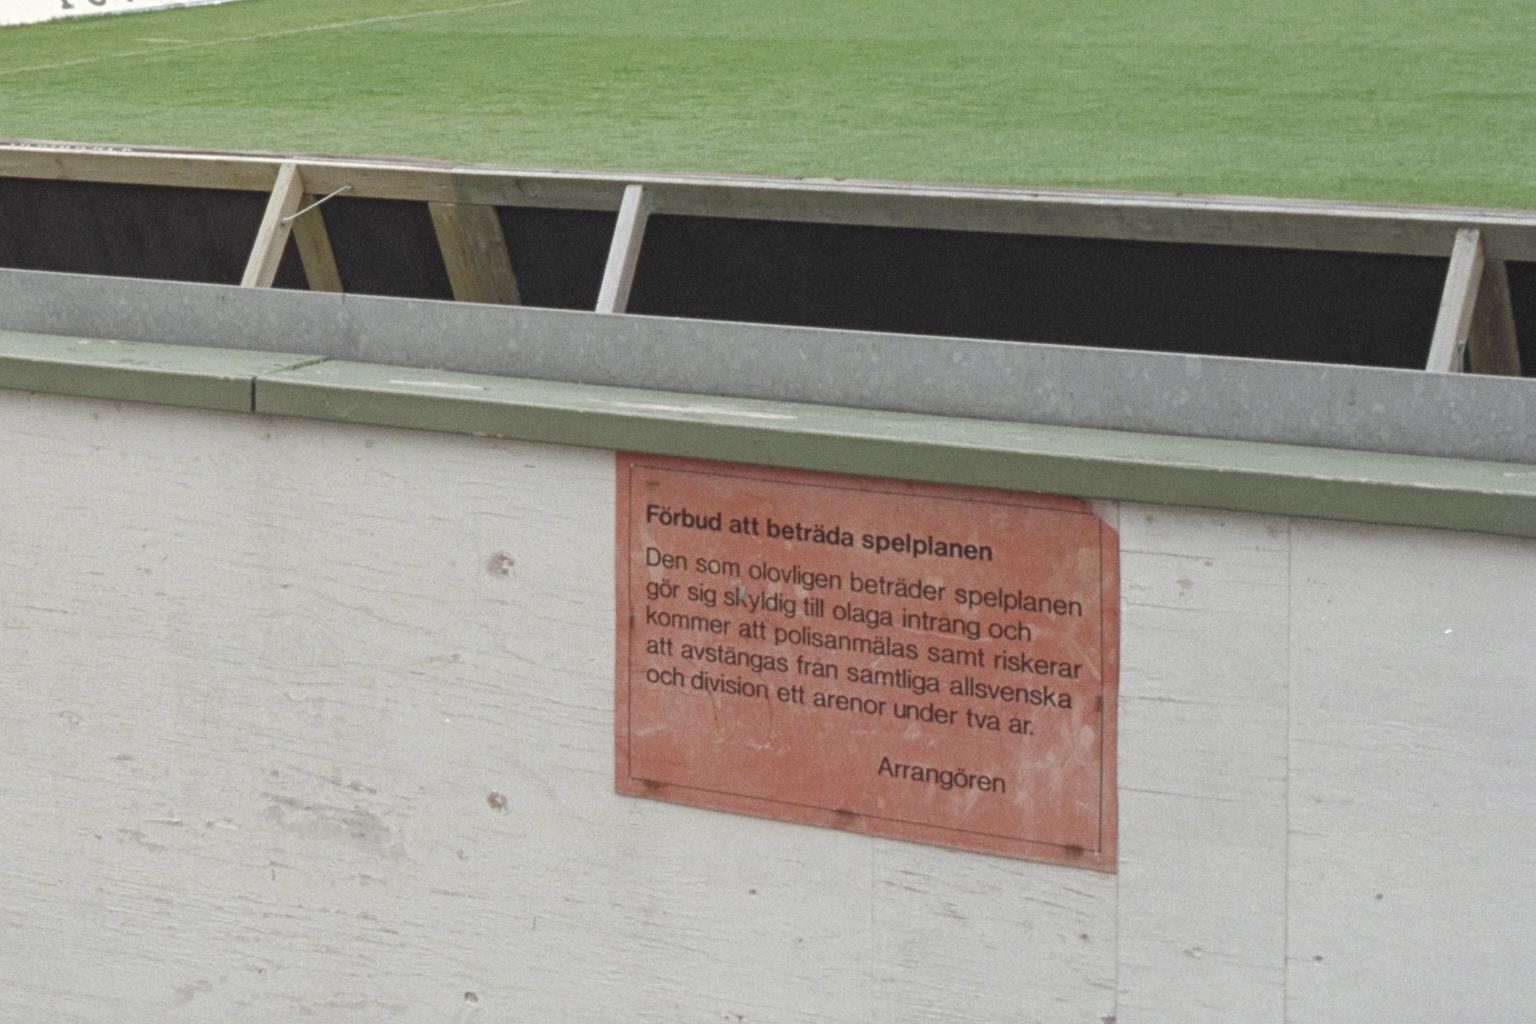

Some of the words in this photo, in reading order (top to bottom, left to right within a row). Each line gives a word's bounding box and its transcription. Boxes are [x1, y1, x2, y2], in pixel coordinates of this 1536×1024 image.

[646, 504, 722, 532] Förbud
[730, 517, 759, 536] att
[766, 519, 854, 547] beträda
[862, 533, 993, 560] spelplanen
[646, 547, 688, 571] Den
[695, 557, 740, 577] som
[749, 562, 842, 591] olovligen
[850, 572, 946, 601] beträder
[955, 587, 1083, 617] spelplanen
[646, 579, 680, 600] gör
[688, 583, 717, 608] sig
[724, 587, 796, 618] skyldig
[803, 597, 825, 618] till
[832, 601, 893, 629] olaga
[988, 622, 1032, 642] och
[646, 606, 731, 634] kommer
[738, 621, 766, 640] att
[774, 625, 918, 660] polisanmälas
[927, 647, 985, 668] samt
[994, 650, 1083, 679] riskerar
[646, 638, 673, 657] att
[681, 644, 789, 673] avstängas
[847, 664, 940, 695] samtliga
[950, 677, 1073, 709] allsvenska
[646, 666, 685, 687] och
[691, 671, 769, 700] division
[777, 684, 806, 705] ett
[814, 690, 886, 716] arenor
[894, 702, 958, 725] under
[878, 756, 1006, 793] Arrangören
